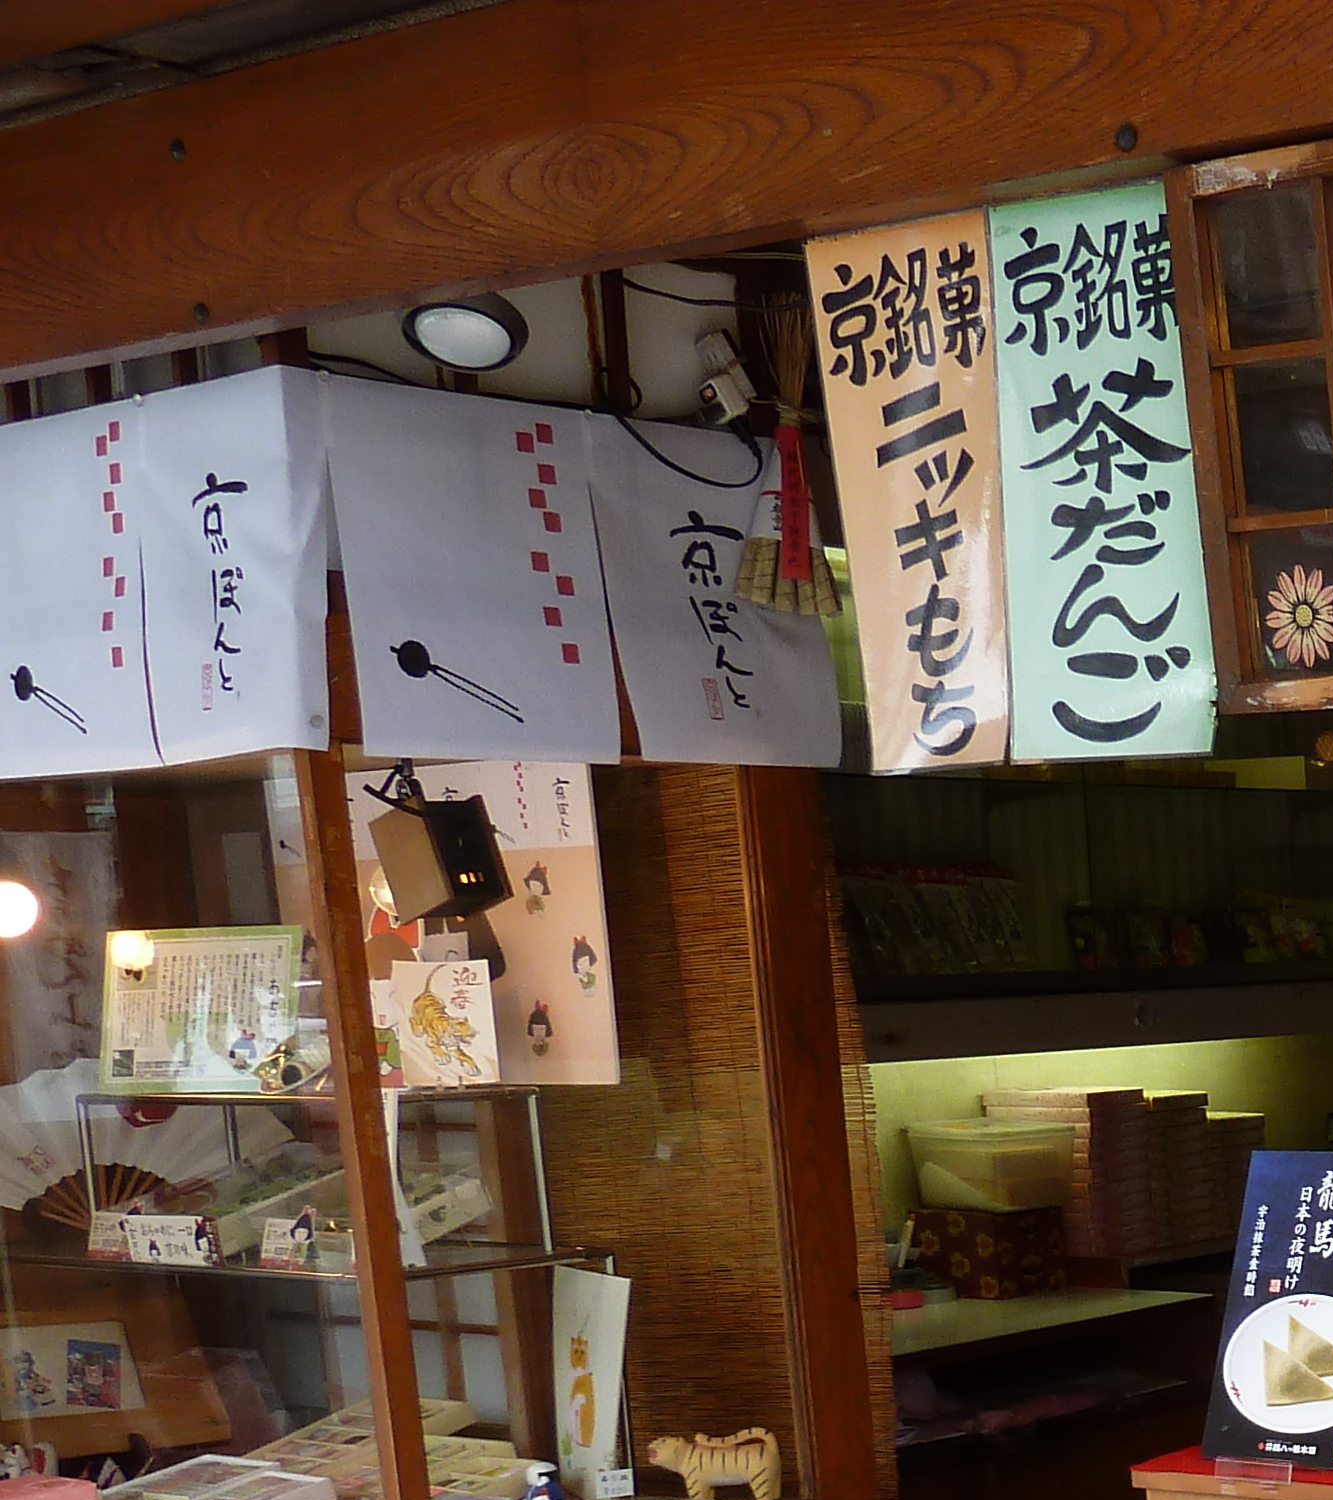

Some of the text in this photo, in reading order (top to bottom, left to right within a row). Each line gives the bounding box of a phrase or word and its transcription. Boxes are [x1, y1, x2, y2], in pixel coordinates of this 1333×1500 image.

[822, 241, 987, 387] 京銘菓
[1003, 213, 1179, 356] 京銘菓
[191, 473, 249, 693] 京ぽんと
[668, 511, 756, 709] 京ぽんと
[876, 381, 976, 756] ニッキもち
[1020, 357, 1192, 743] 茶だんご
[450, 966, 484, 1011] 迎春
[1284, 1186, 1314, 1291] 日本の夜明け
